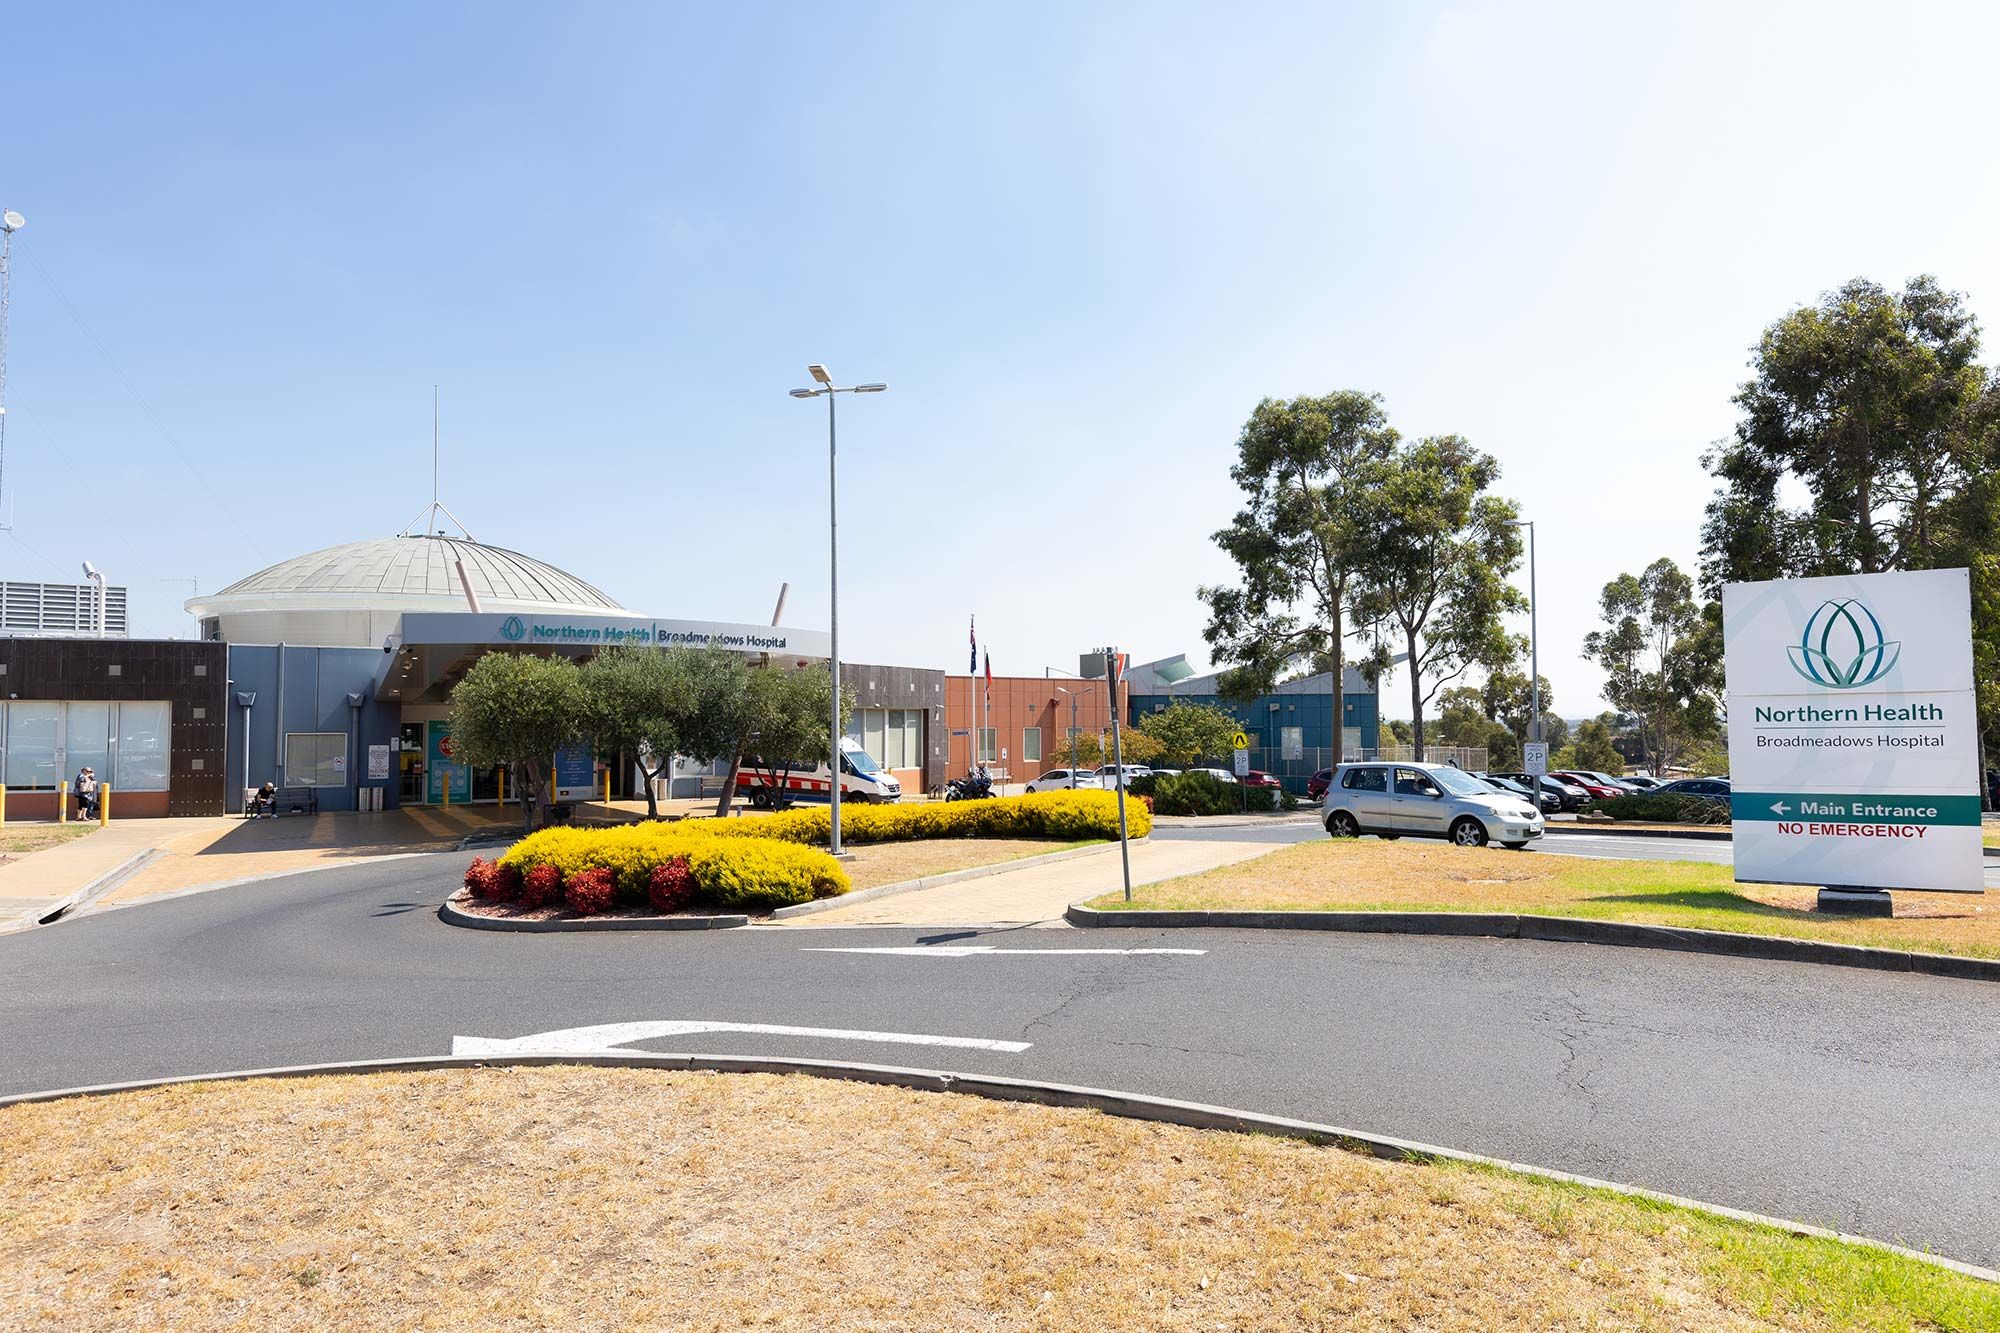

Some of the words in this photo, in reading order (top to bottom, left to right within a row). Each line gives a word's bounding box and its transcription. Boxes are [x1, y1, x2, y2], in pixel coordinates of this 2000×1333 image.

[533, 624, 600, 639] Northern
[746, 635, 787, 649] Hospital
[1755, 705, 1858, 722] Northern
[1864, 703, 1943, 721] Health
[1757, 735, 1873, 747] Broadmeadows
[1877, 734, 1944, 749] Hospital
[1527, 752, 1543, 761] 2P
[1801, 802, 1845, 816] Main
[1852, 803, 1938, 817] Entrance
[1778, 823, 1803, 835] NO
[1809, 824, 1927, 838] EMERGENCY
